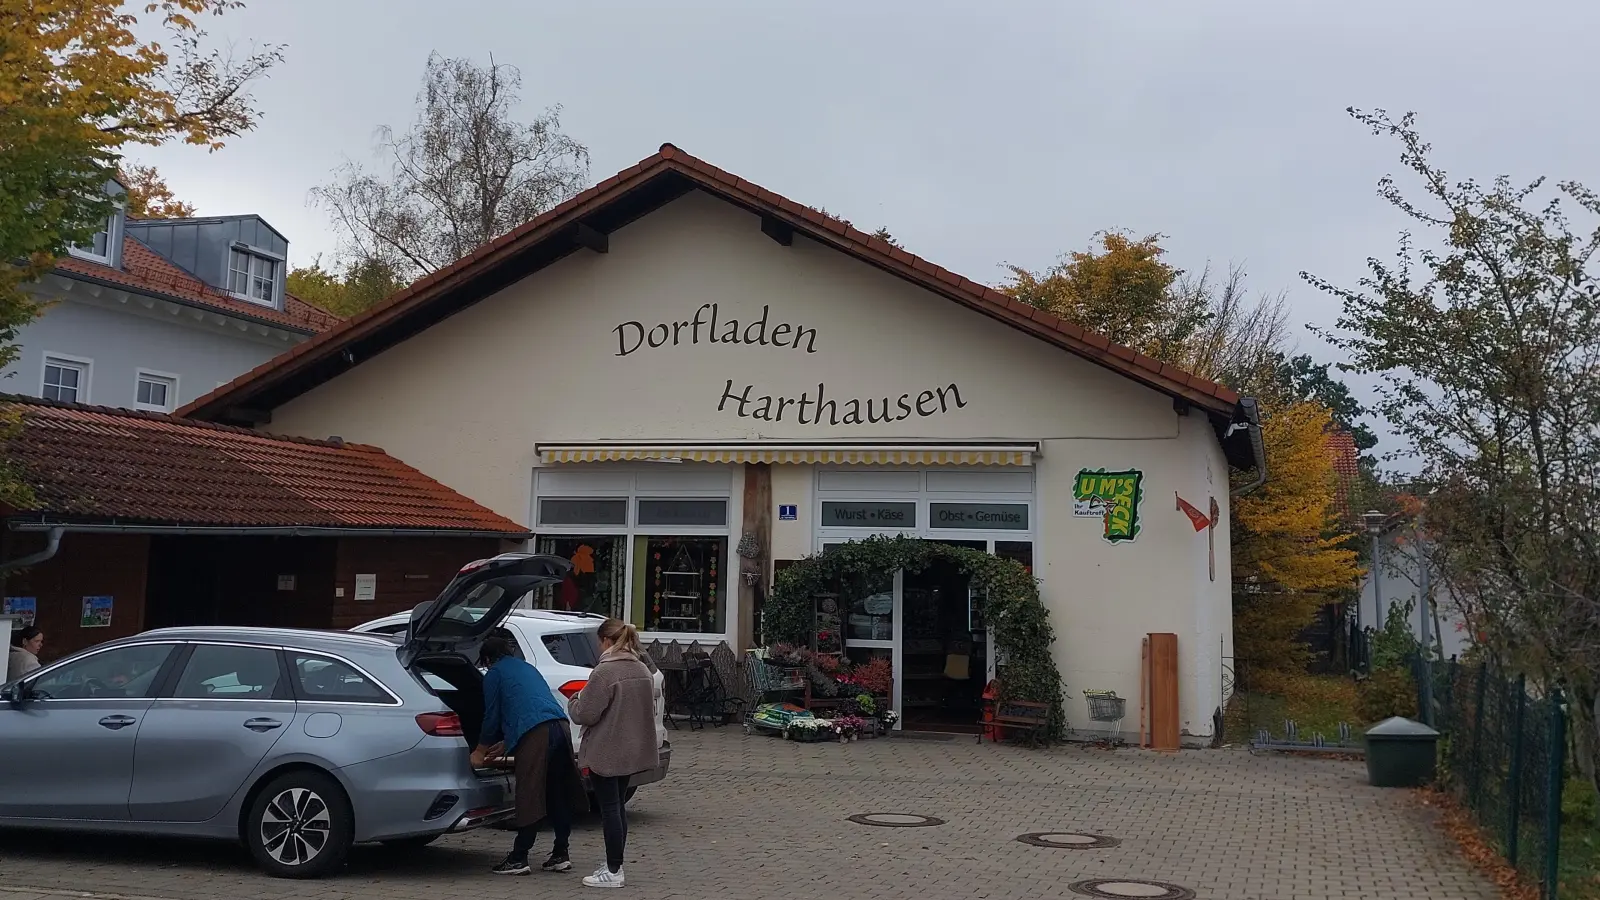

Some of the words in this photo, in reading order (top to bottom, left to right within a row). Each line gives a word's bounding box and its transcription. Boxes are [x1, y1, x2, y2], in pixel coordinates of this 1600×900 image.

[612, 303, 818, 356] Dorfladen
[717, 380, 968, 426] Harthausen
[834, 508, 867, 520] Wurst
[877, 508, 904, 520] Käse
[939, 509, 965, 521] Obst
[975, 510, 1021, 523] Gemüse
[1112, 494, 1131, 535] ECK
